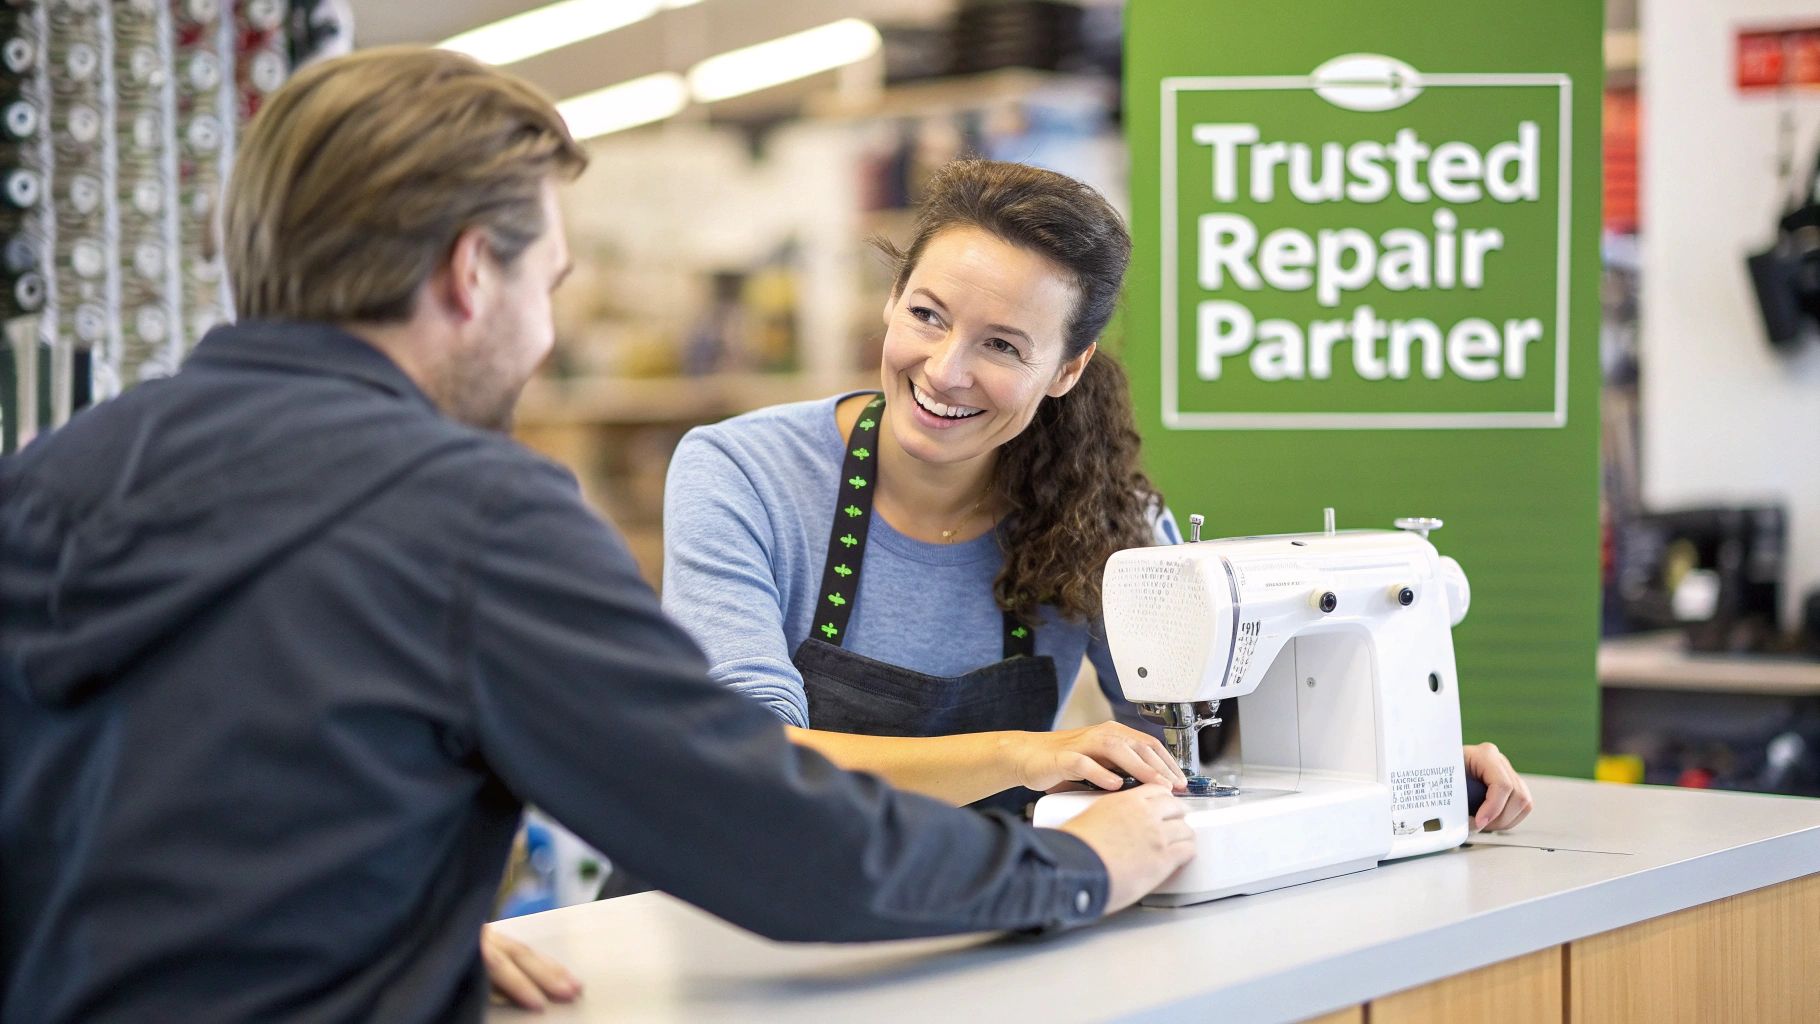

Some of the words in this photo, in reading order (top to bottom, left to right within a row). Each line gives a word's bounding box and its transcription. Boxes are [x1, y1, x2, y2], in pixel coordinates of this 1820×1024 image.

[1193, 121, 1539, 203] Trusted
[1197, 208, 1503, 306] Repair
[1197, 300, 1542, 380] Partner
